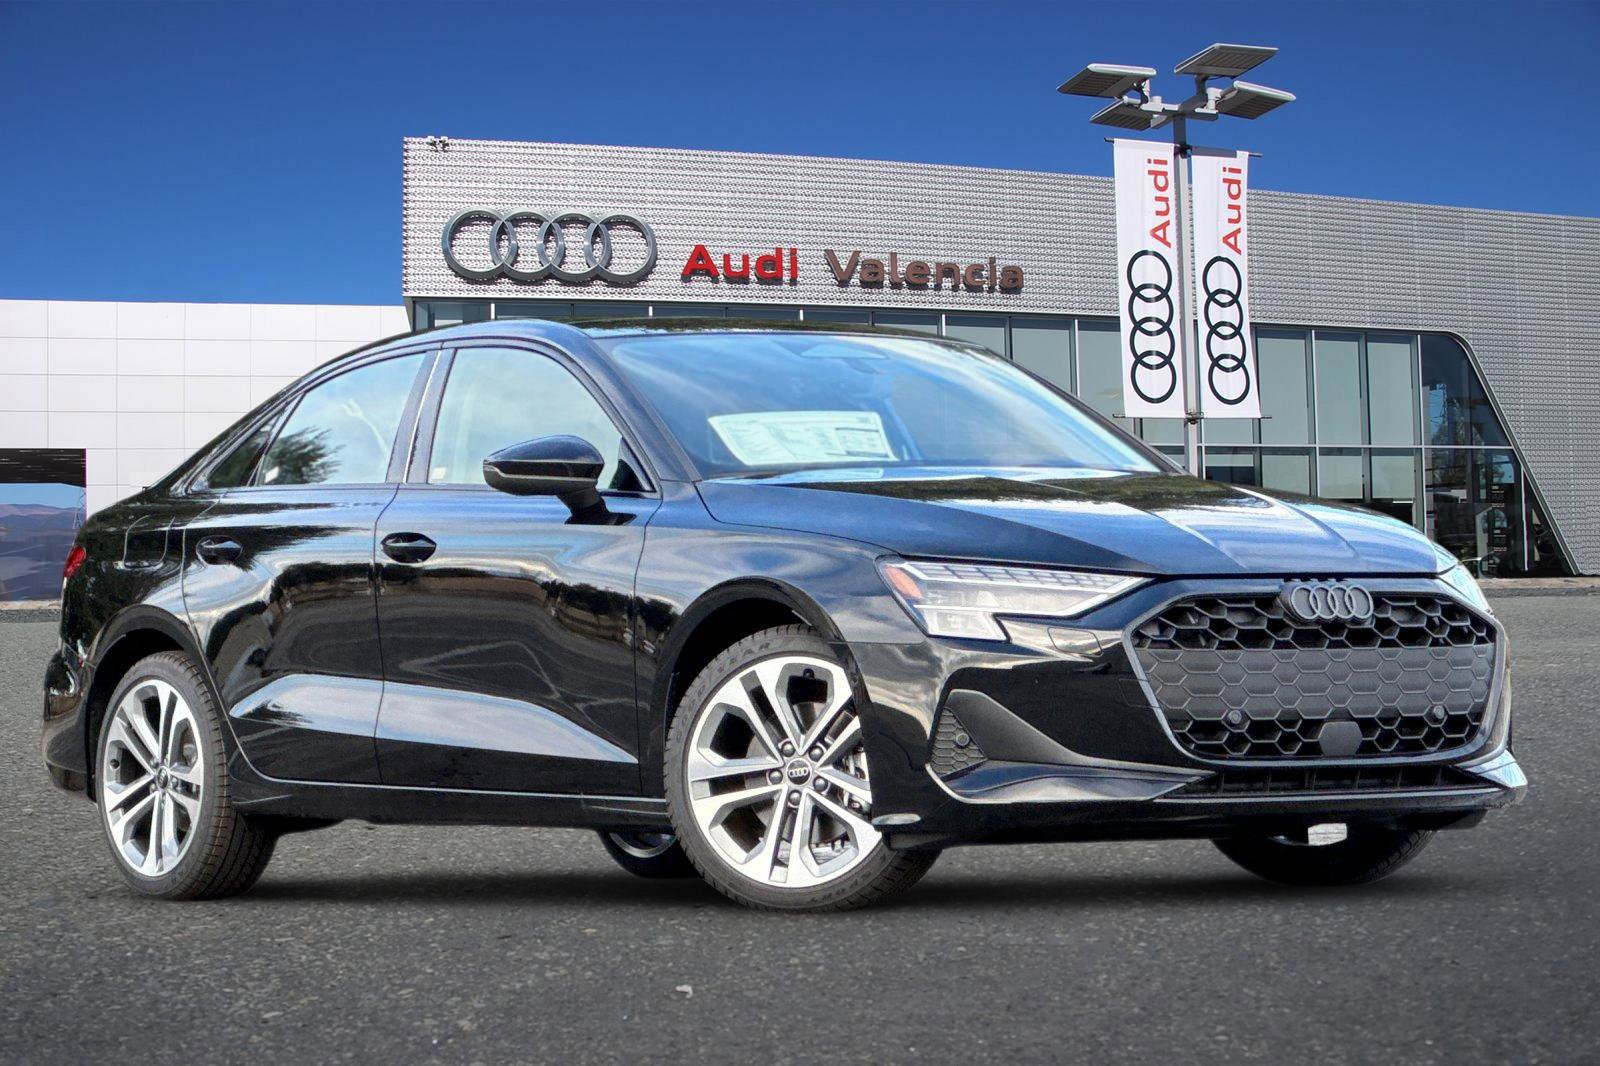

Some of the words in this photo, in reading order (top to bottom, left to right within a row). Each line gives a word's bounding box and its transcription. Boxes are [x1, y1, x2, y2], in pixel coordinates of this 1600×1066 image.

[1147, 158, 1171, 248] Audi
[1222, 167, 1242, 255] Audi
[681, 244, 799, 282] Audi
[824, 249, 1024, 291] Valencia
